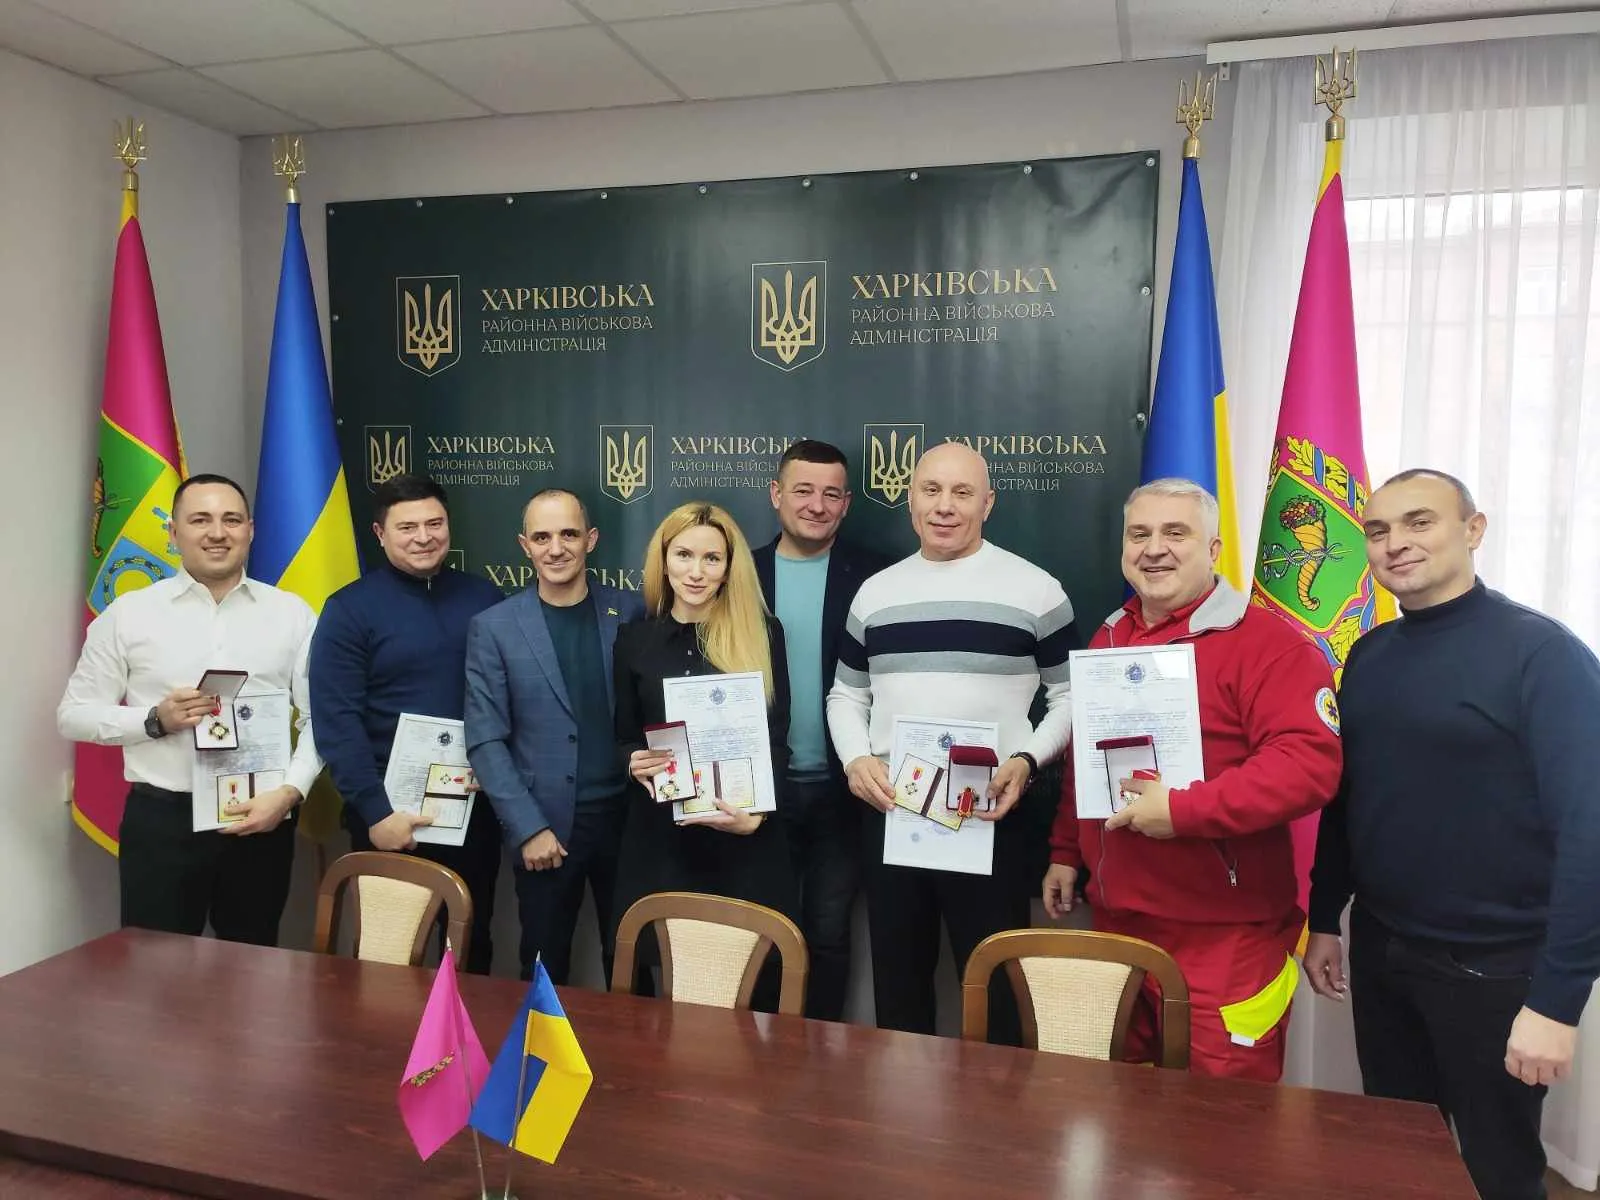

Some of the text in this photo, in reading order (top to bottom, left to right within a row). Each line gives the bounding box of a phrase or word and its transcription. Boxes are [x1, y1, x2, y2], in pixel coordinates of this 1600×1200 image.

[851, 267, 1057, 300] ХАРКІВСЬКА
[481, 284, 655, 311] ХАРКІВСЬКА
[851, 301, 1056, 323] РАЙОННА ВІЙСЬКОВА
[482, 314, 653, 333] РАЙОННА ВІЙСЬКОВА
[850, 326, 998, 345] АДМІНІСТРАЦІЯ
[482, 337, 606, 353] АДМІНІСТРАЦІЯ
[427, 436, 555, 454] ХАРКІВСЬКА
[671, 436, 808, 455] ХАРКІВСЬК
[428, 458, 554, 471] РАЙОННА ВІЙСЬКОВА
[671, 458, 734, 472] РАЙОННА
[1018, 459, 1105, 474] ВІЙСЬКОВА
[993, 478, 1060, 491] ІСТРАЦІЯ
